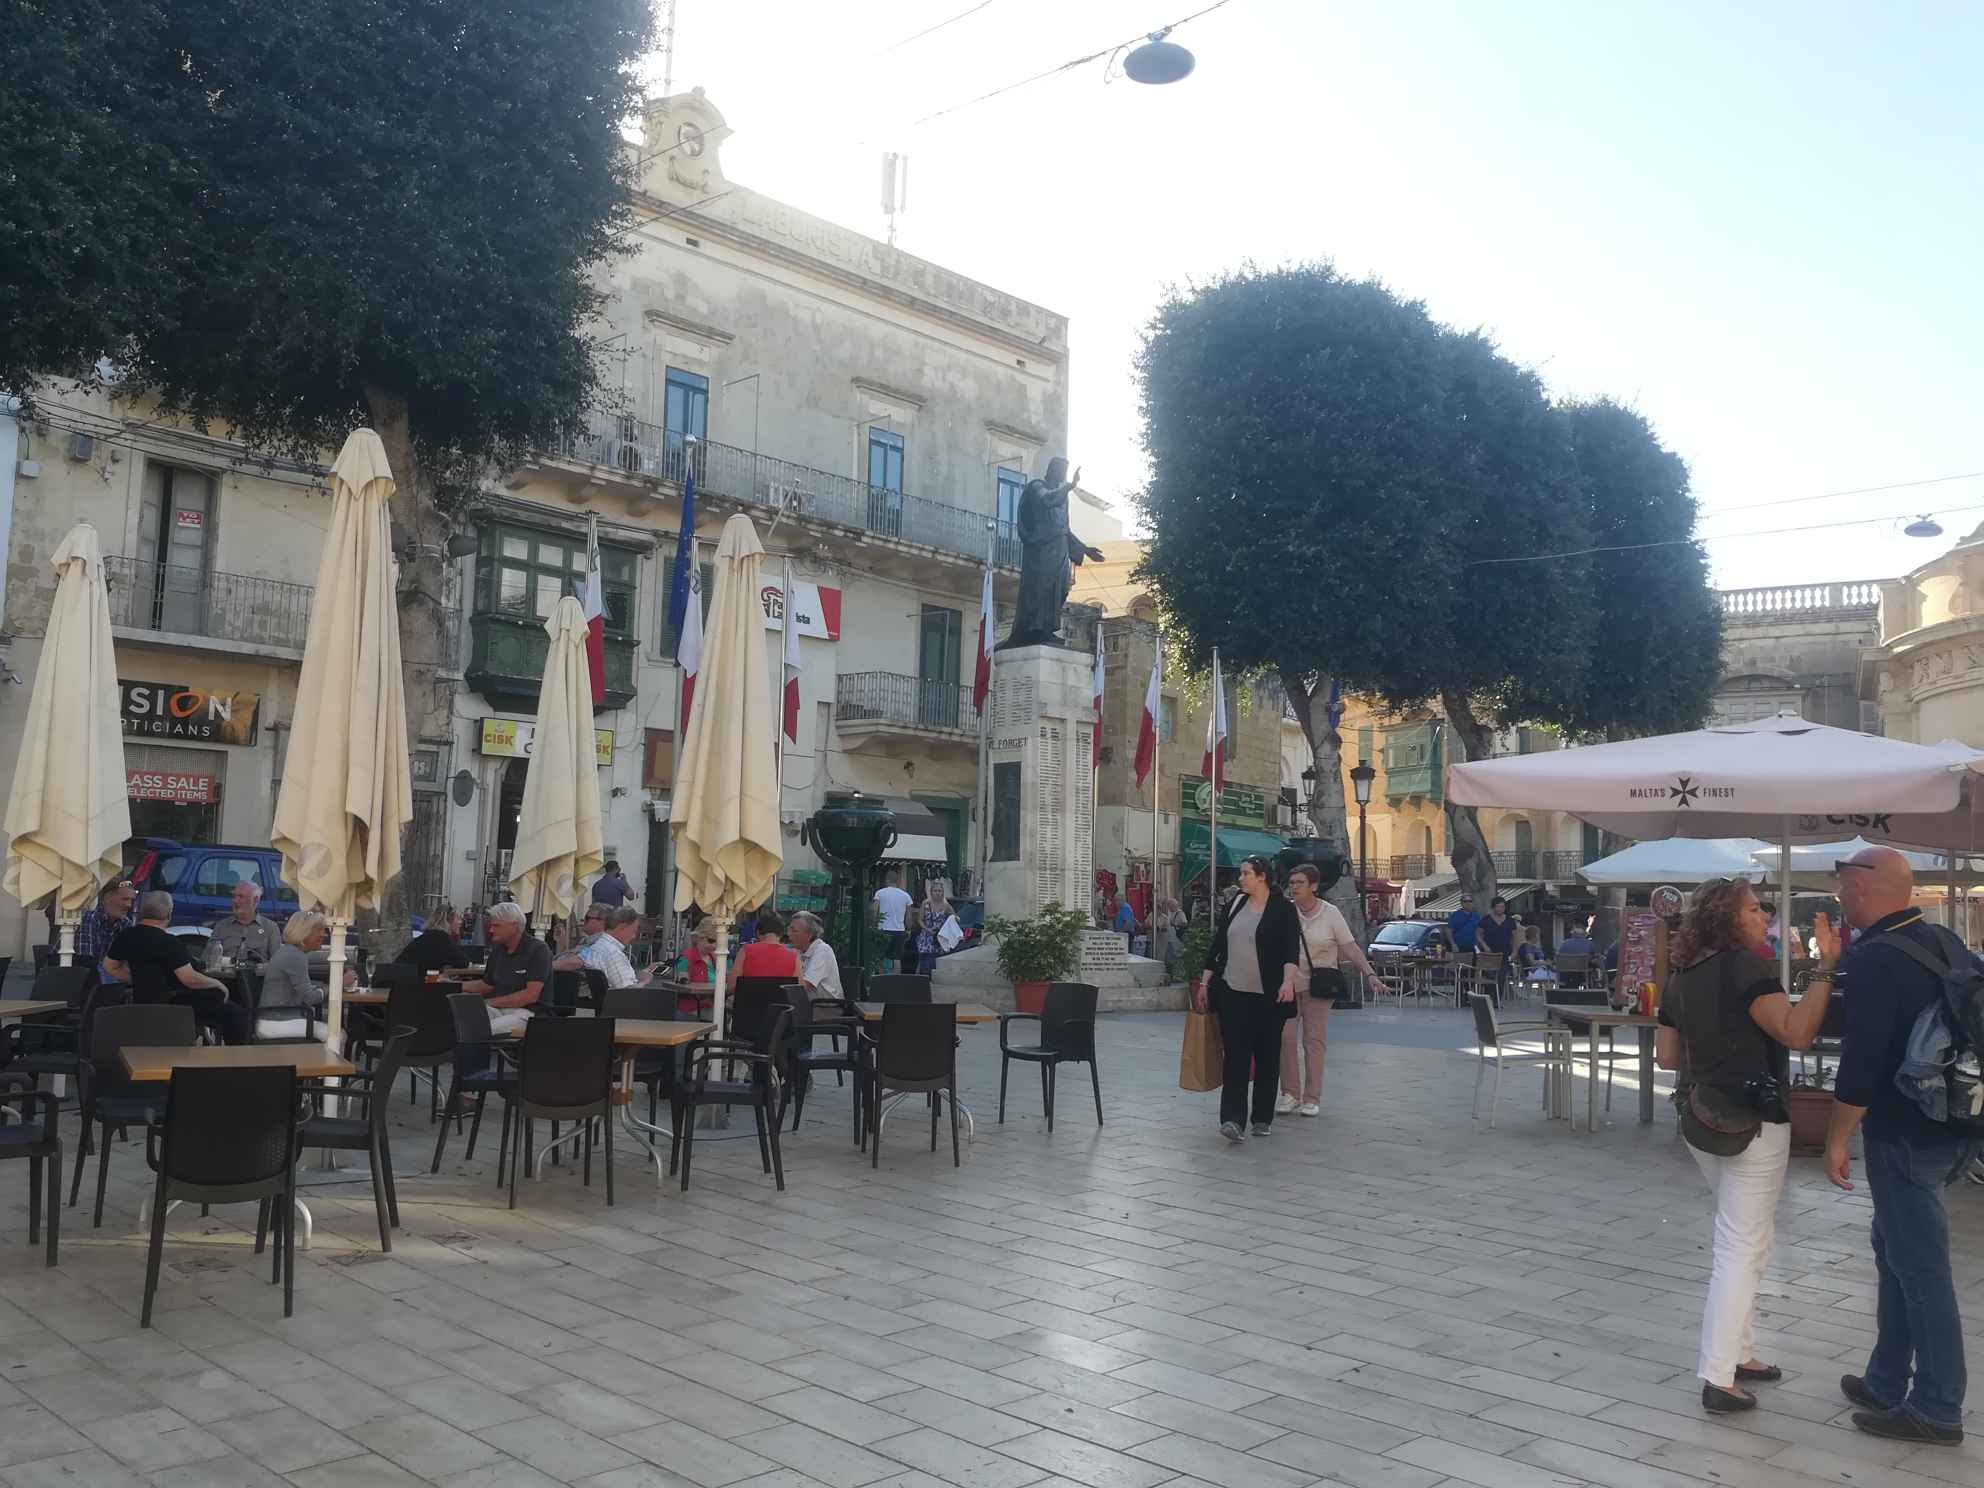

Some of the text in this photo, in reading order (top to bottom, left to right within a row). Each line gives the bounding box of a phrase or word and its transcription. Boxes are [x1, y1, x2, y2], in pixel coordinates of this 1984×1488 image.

[120, 718, 211, 737] PTICIANS
[484, 733, 514, 746] CISK
[167, 776, 209, 791] SALE
[127, 787, 208, 801] ELECTED ITEMS
[1630, 787, 1736, 798] MALTA'S FINEST
